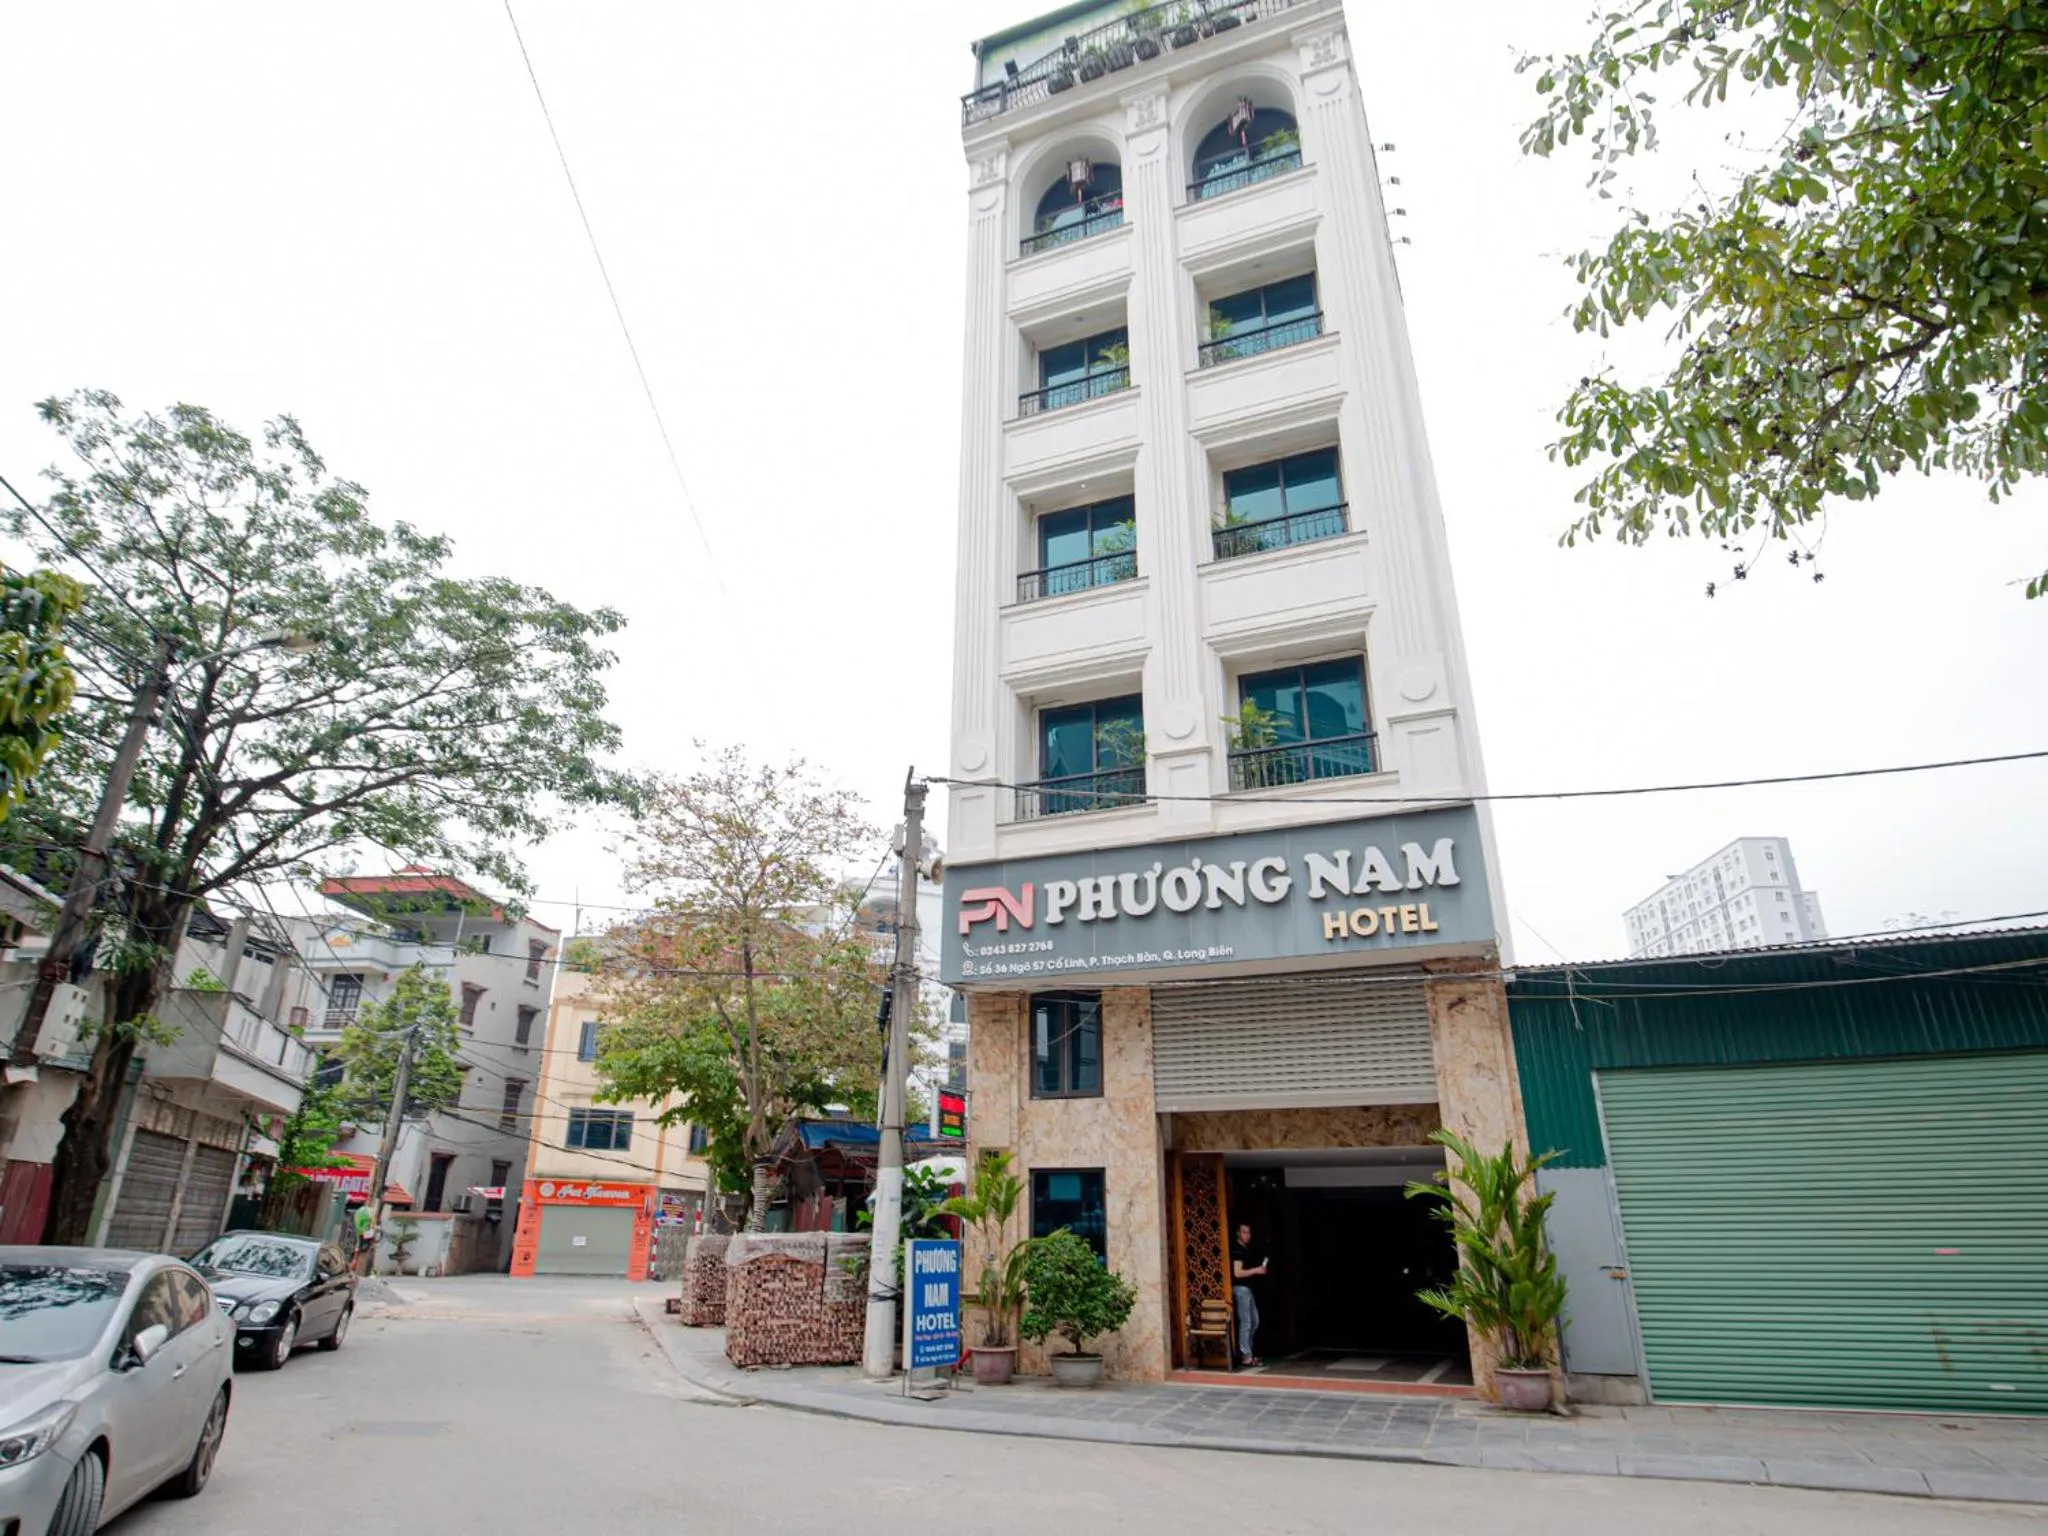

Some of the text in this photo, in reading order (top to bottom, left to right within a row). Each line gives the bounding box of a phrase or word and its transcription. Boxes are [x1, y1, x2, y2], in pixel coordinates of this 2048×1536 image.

[1044, 838, 1461, 924] PHƯƠNG NAM
[958, 882, 1035, 935] PN
[1322, 903, 1439, 940] HOTEL
[980, 940, 1054, 956] 0243 827 2768
[1090, 956, 1101, 966] P.
[1177, 949, 1206, 960] Long
[924, 1283, 949, 1308] NAM
[915, 1311, 956, 1332] HOTEL
